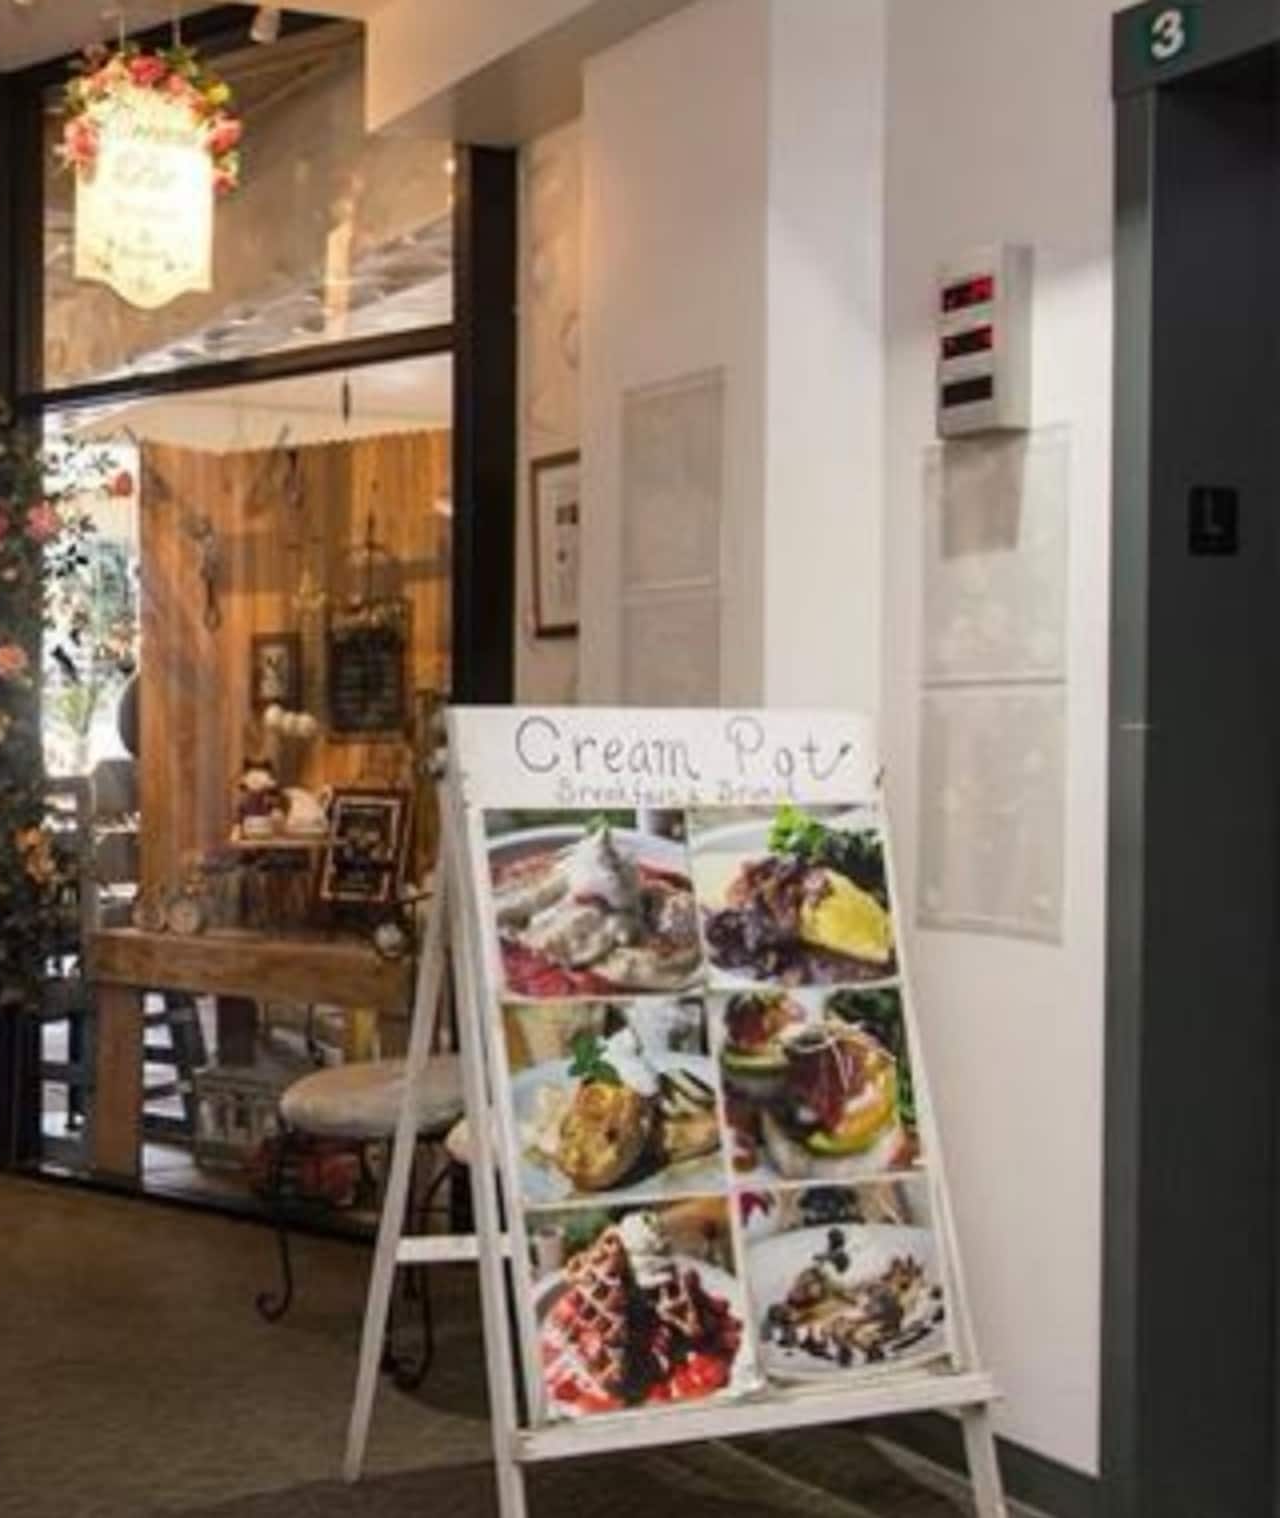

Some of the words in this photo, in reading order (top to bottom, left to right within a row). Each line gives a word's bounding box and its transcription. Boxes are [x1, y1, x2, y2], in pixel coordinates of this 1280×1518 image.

[1150, 9, 1186, 60] 3
[514, 715, 700, 780] Cream
[725, 716, 852, 780] Pot
